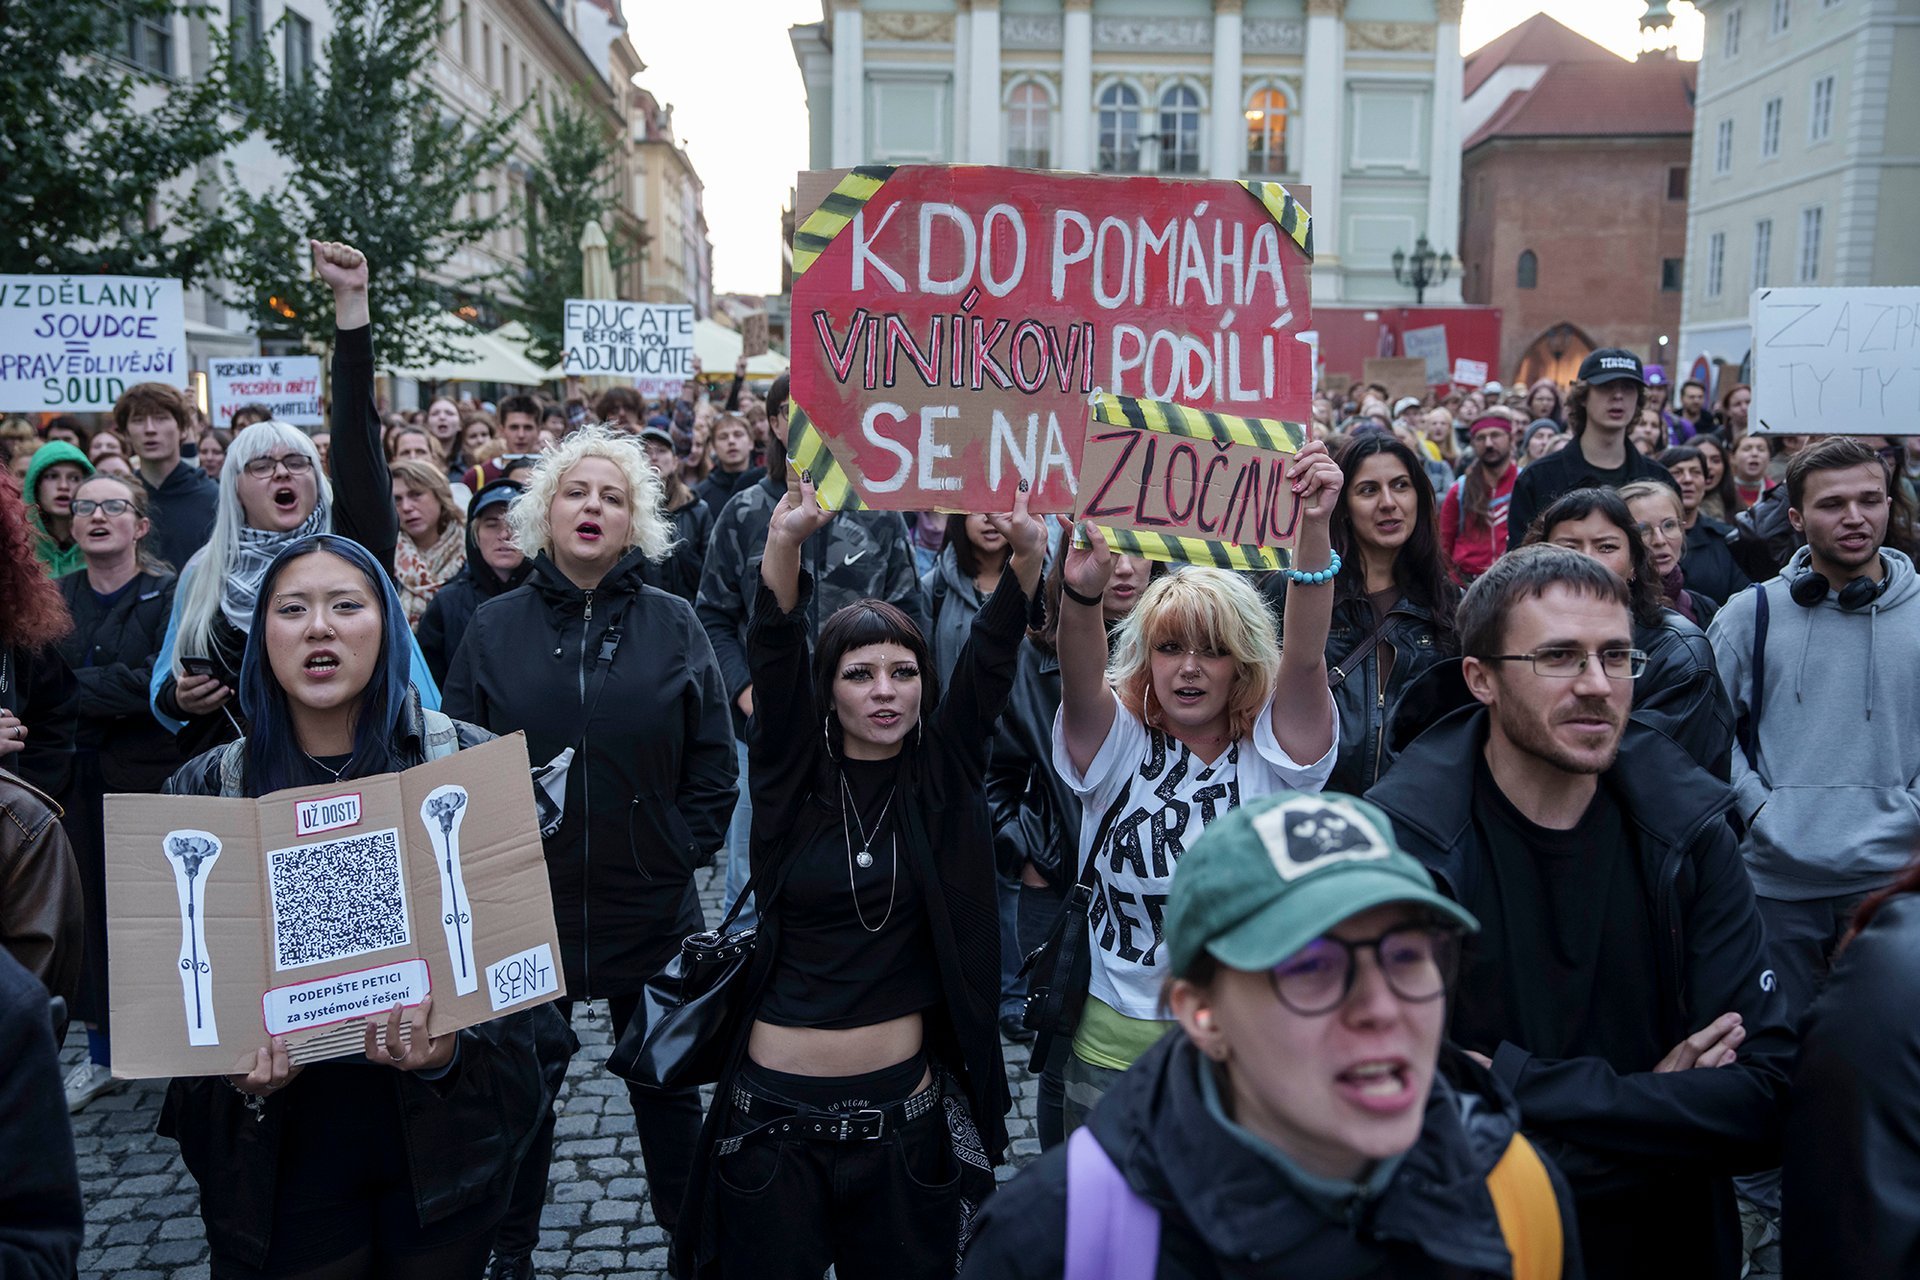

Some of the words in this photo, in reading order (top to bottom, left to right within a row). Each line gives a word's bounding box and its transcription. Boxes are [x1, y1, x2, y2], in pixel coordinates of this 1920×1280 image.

[852, 201, 1027, 297] KDO
[1053, 201, 1288, 309] POMÁHA
[34, 314, 158, 339] SOUDCE
[567, 303, 693, 334] EDUCATE
[583, 329, 636, 345] BEFORE
[640, 333, 669, 346] YOU
[813, 286, 1095, 394] VINÍKOVI
[1112, 310, 1294, 402] PODÍLÍ
[0, 347, 176, 381] PRAVEDLIVĚJŠÍ
[565, 344, 693, 374] ADJUDICATE
[44, 377, 125, 405] SOUD
[1779, 363, 1835, 418] TY
[1852, 367, 1900, 417] TY
[861, 402, 963, 494] SE
[990, 409, 1079, 496] NA
[1081, 430, 1302, 548] ZLOČINU
[303, 804, 319, 828] UŽ
[322, 801, 357, 825] DOST!
[494, 954, 536, 988] KON
[499, 966, 550, 1003] SENT
[287, 1013, 301, 1023] za
[304, 995, 370, 1020] systémové
[372, 986, 410, 1005] řešení
[289, 981, 359, 1005] PODEPIŠTE
[362, 972, 401, 989] PETICI
[828, 1102, 840, 1112] GO
[842, 1099, 870, 1108] VEGAN
